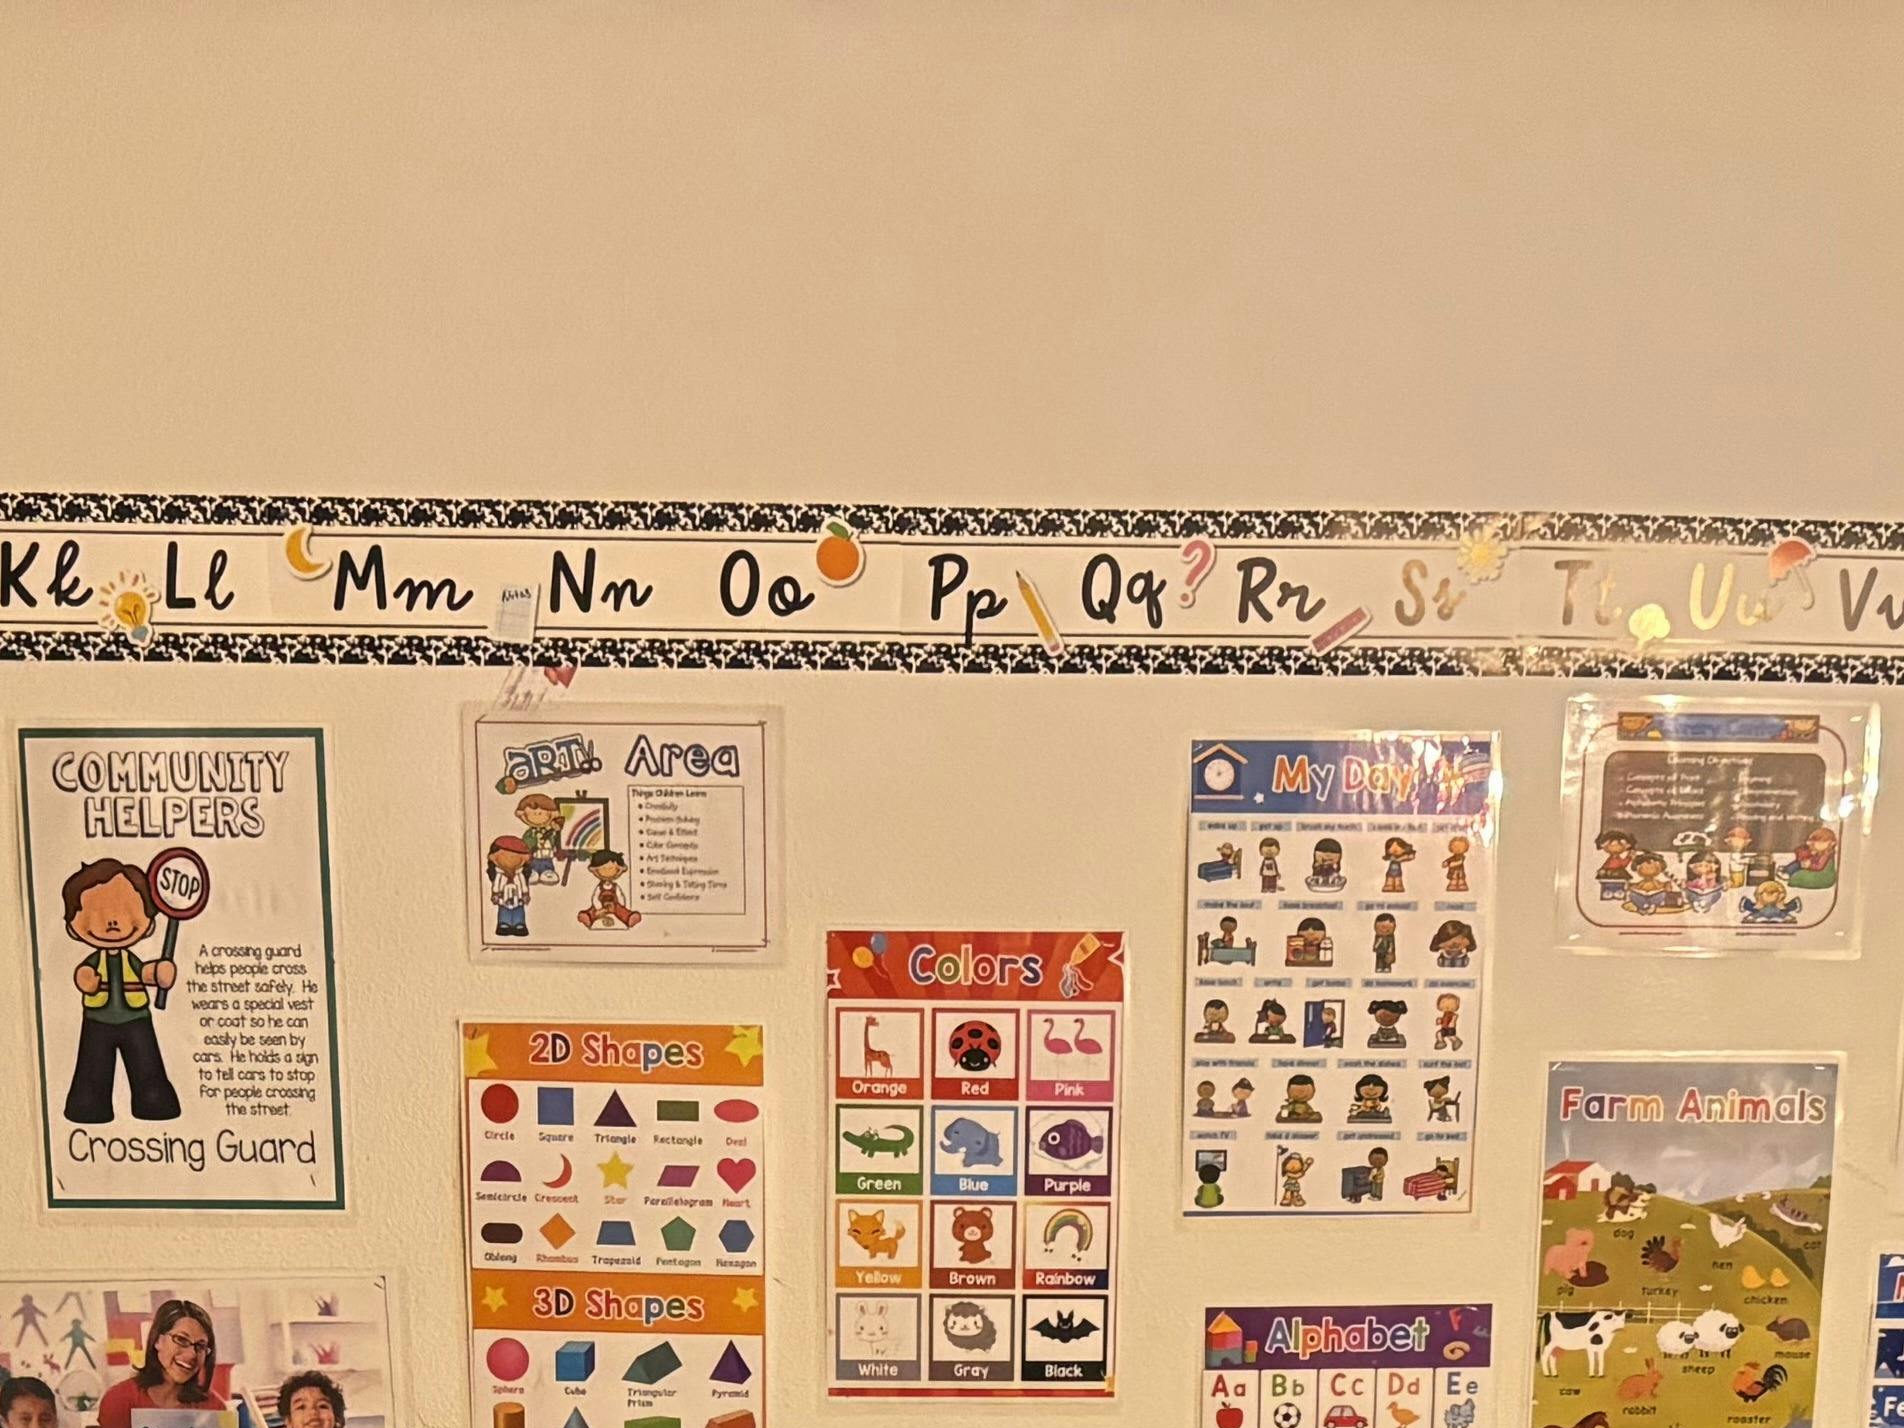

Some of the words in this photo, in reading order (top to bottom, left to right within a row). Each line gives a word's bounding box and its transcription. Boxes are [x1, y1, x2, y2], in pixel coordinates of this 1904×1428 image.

[0, 542, 96, 607] Kk
[165, 542, 235, 607] Ll
[333, 544, 473, 613] Mm
[551, 549, 654, 614] Nn
[721, 549, 815, 616] Oo
[930, 555, 1010, 647] Pp
[1082, 555, 1168, 630] Qq
[1238, 557, 1325, 622] Rr
[1396, 559, 1467, 626] Ss
[1554, 559, 1629, 628] Tt
[1690, 563, 1774, 631] Uu
[624, 734, 740, 777] Area
[52, 751, 289, 793] COMMUNITY
[1272, 754, 1335, 802] My
[1343, 755, 1414, 802] Day
[84, 797, 265, 838] HELPERS
[160, 866, 200, 901] STOP
[199, 945, 209, 957] A
[211, 945, 262, 961] crossing
[265, 945, 302, 960] guard
[195, 962, 227, 976] helps
[230, 963, 268, 978] people
[272, 963, 307, 975] cross
[909, 943, 1043, 987] Colors
[186, 980, 207, 992] the
[211, 980, 251, 993] street
[254, 980, 295, 996] safely.
[302, 981, 318, 994] He
[192, 999, 228, 1010] wears
[232, 1000, 240, 1010] a
[243, 998, 284, 1013] special
[287, 1000, 314, 1010] vest
[199, 1017, 211, 1028] or
[214, 1016, 247, 1028] coat
[250, 1017, 265, 1028] so
[268, 1016, 283, 1028] he
[286, 1017, 308, 1028] can
[204, 1034, 237, 1048] easily
[240, 1033, 255, 1045] be
[259, 1035, 286, 1046] seen
[289, 1034, 305, 1048] by
[193, 1051, 222, 1063] cars.
[230, 1051, 246, 1063] He
[249, 1051, 281, 1064] holds
[285, 1053, 292, 1063] a
[296, 1051, 319, 1065] sign
[529, 1033, 571, 1063] 2D
[583, 1033, 704, 1074] Shapes
[199, 1070, 212, 1081] to
[216, 1068, 234, 1081] tell
[238, 1070, 265, 1081] cars
[269, 1070, 283, 1081] to
[286, 1070, 315, 1084] stop
[199, 1086, 221, 1098] for
[224, 1086, 262, 1102] people
[265, 1086, 316, 1102] crossing
[851, 1080, 907, 1096] Orange
[961, 1082, 989, 1096] Red
[1055, 1083, 1084, 1097] Pink
[226, 1103, 247, 1115] the
[250, 1103, 292, 1116] street.
[1561, 1087, 1663, 1122] Farm
[1679, 1087, 1826, 1124] Animals
[595, 1133, 637, 1145] Triangle
[68, 1129, 205, 1172] Crossing
[216, 1129, 316, 1164] Guard
[857, 1176, 902, 1191] Green
[959, 1178, 989, 1192] Blue
[1044, 1179, 1091, 1193] Purple
[855, 1271, 902, 1285] Yellow
[949, 1271, 996, 1286] Brown
[1035, 1272, 1096, 1286] Rainbow
[1642, 1286, 1679, 1298] turkey
[1744, 1294, 1788, 1305] chicken
[533, 1287, 574, 1317] 3D
[586, 1289, 704, 1325] Shapes
[1265, 1316, 1429, 1360] Alphabet
[858, 1363, 898, 1377] White
[954, 1363, 989, 1379] Gray
[1045, 1364, 1083, 1378] Black
[1683, 1364, 1714, 1376] sheep
[1623, 1404, 1657, 1416] rabbit
[1727, 1413, 1771, 1424] rooster
